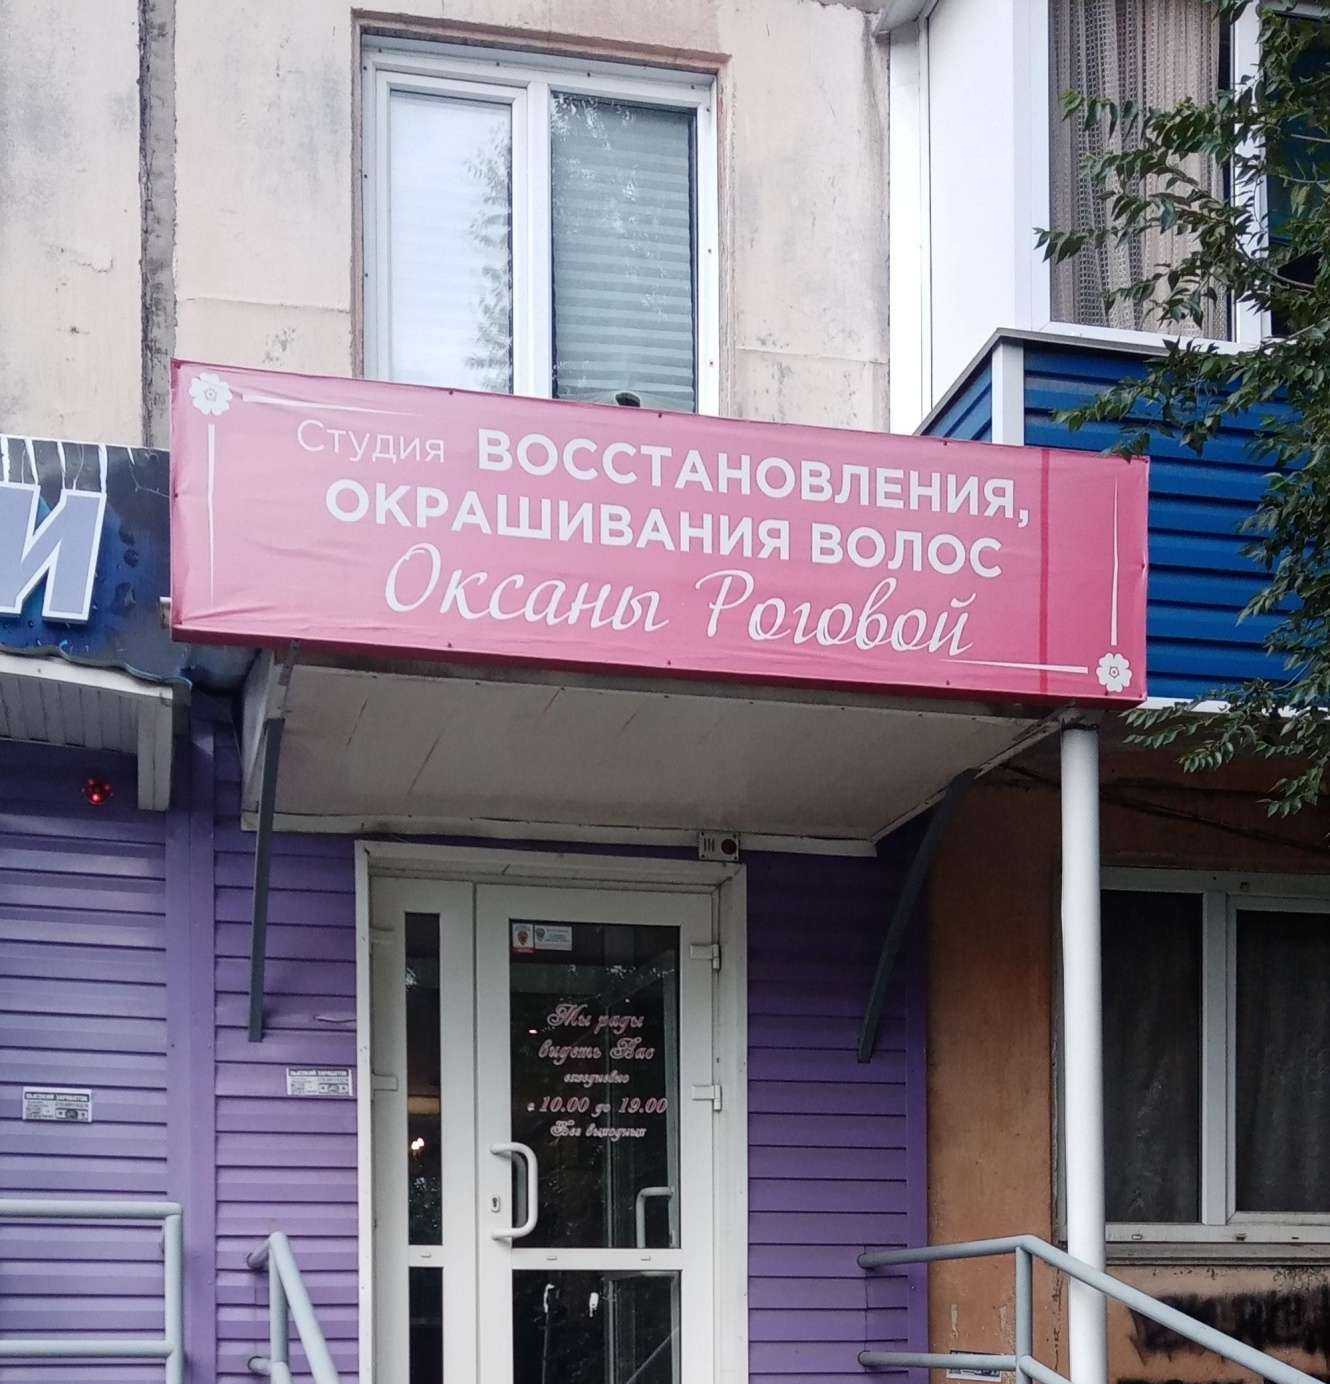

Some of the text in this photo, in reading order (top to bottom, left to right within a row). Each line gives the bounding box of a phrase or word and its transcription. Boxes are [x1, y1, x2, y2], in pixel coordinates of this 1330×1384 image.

[297, 419, 1030, 529] Студия ВОССТАНОВЛЕНИЯ,
[325, 478, 1003, 579] ОКРАШИВАНИЯ ВОЛОС
[385, 542, 977, 657] Оксаны Роговой
[547, 1003, 645, 1034] Мы рады
[538, 1036, 656, 1065] видеть Вас
[563, 1070, 630, 1087] ежедневно
[539, 1096, 591, 1113] 10.00
[591, 1103, 611, 1117] до
[618, 1097, 668, 1114] 19.00
[585, 1122, 647, 1142] выходных
